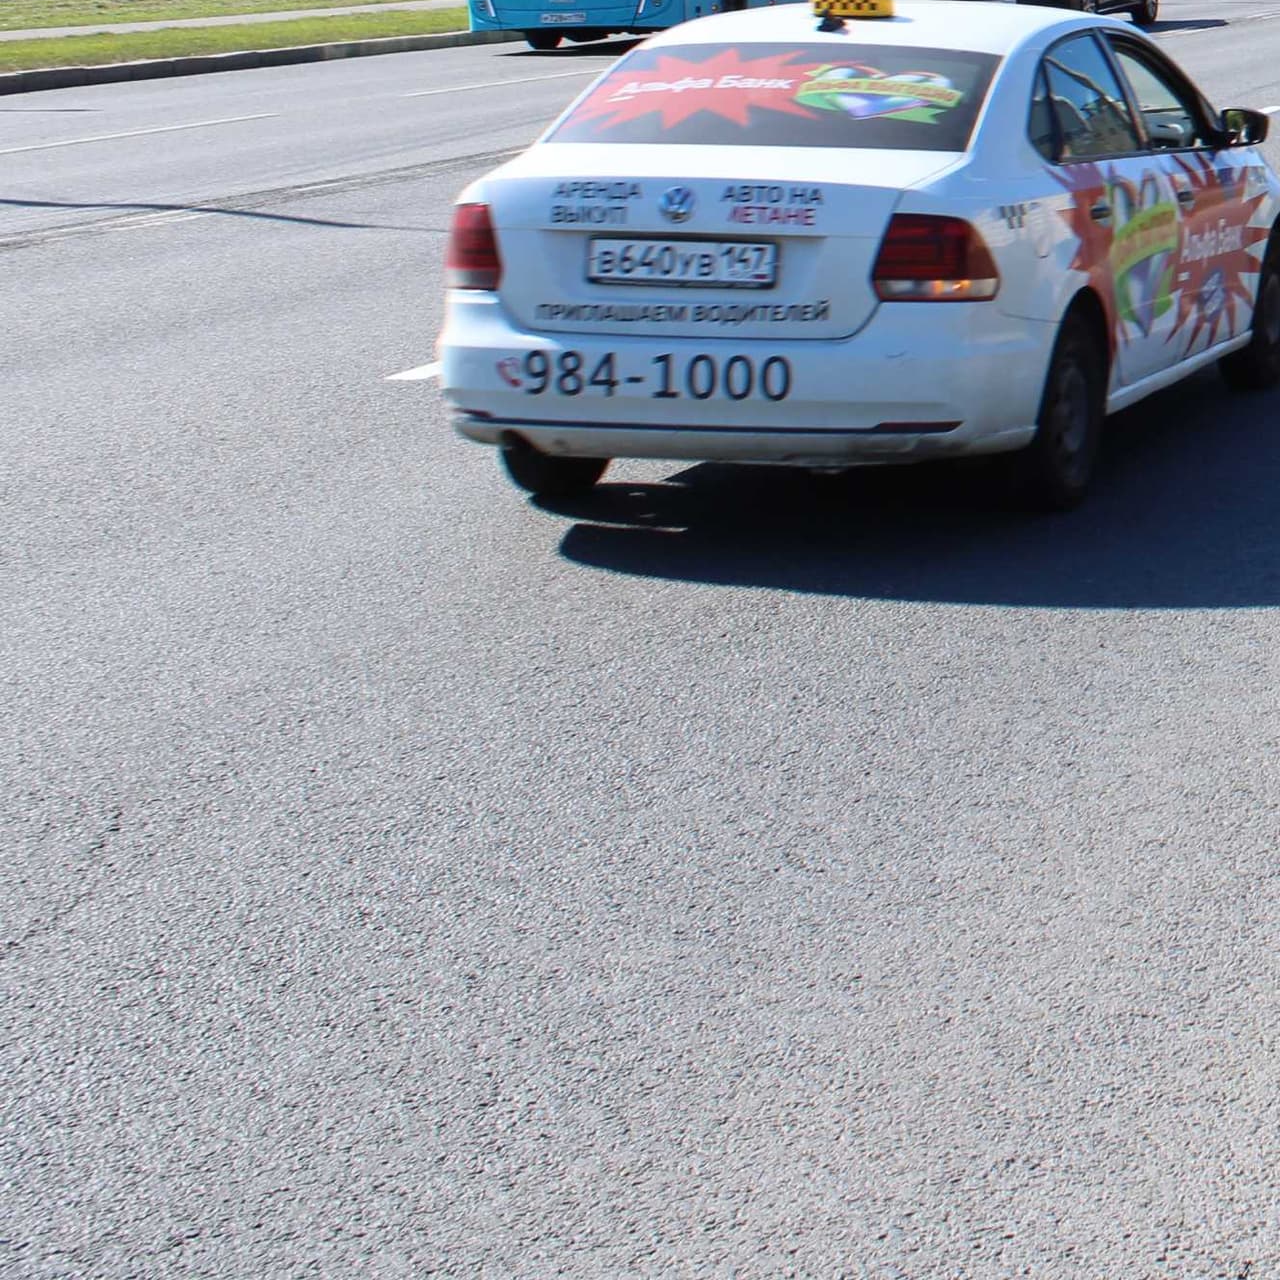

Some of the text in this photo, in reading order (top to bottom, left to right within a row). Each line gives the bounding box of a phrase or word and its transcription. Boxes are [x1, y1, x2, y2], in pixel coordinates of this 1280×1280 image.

[714, 74, 796, 89] Банк
[553, 181, 643, 200] АРЕНДА
[720, 185, 825, 205] АВТО НА
[551, 205, 630, 224] ВЫКУП
[534, 298, 831, 325] ПРИГЛАШАЕМ ВОДИТЕЛЕЙ
[524, 349, 793, 402] 984-1000
